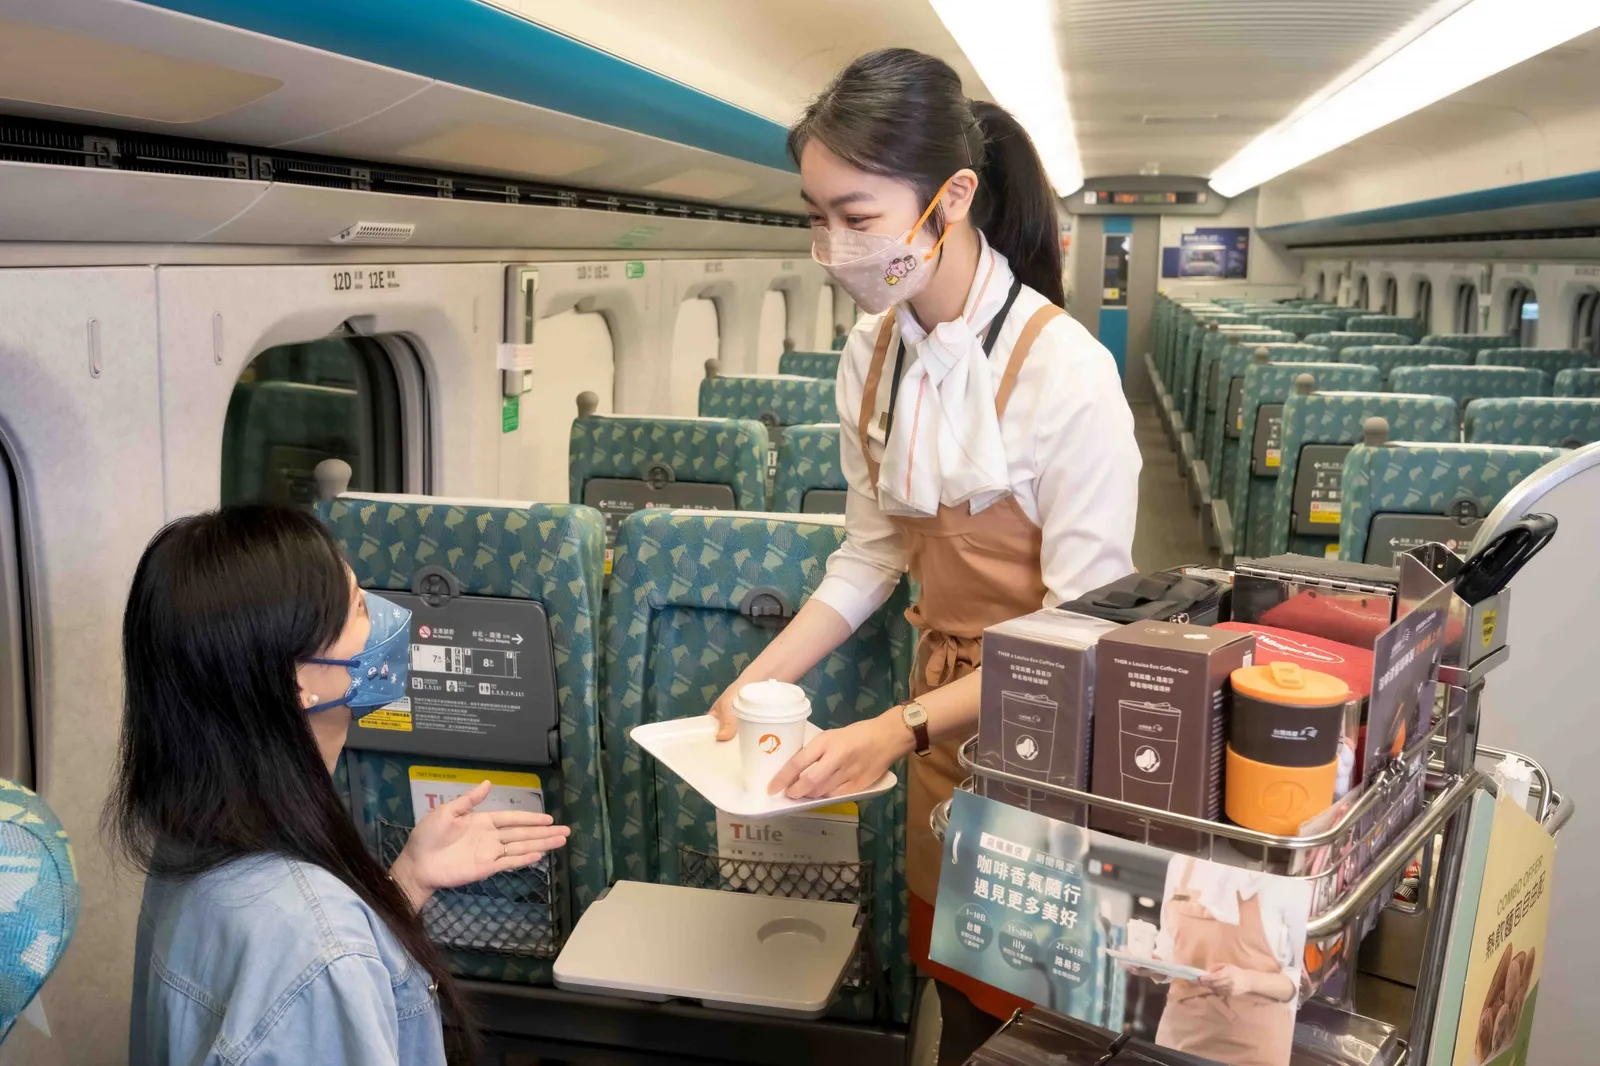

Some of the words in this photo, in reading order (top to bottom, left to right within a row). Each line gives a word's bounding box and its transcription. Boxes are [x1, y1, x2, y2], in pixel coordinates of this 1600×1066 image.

[333, 272, 351, 290] 12D
[368, 271, 384, 289] 12E
[432, 655, 438, 663] 7
[483, 659, 490, 667] 8
[1039, 659, 1055, 667] Coffee
[1160, 665, 1177, 673] Coffee
[730, 823, 783, 842] TLife
[1035, 853, 1076, 875] 期間限定
[976, 854, 1081, 905] 咖啡香氣隨行
[1497, 878, 1522, 916] COMBO
[1523, 854, 1543, 887] OFFER
[973, 877, 1078, 929] 遇見更多美好
[1012, 938, 1026, 952] illy
